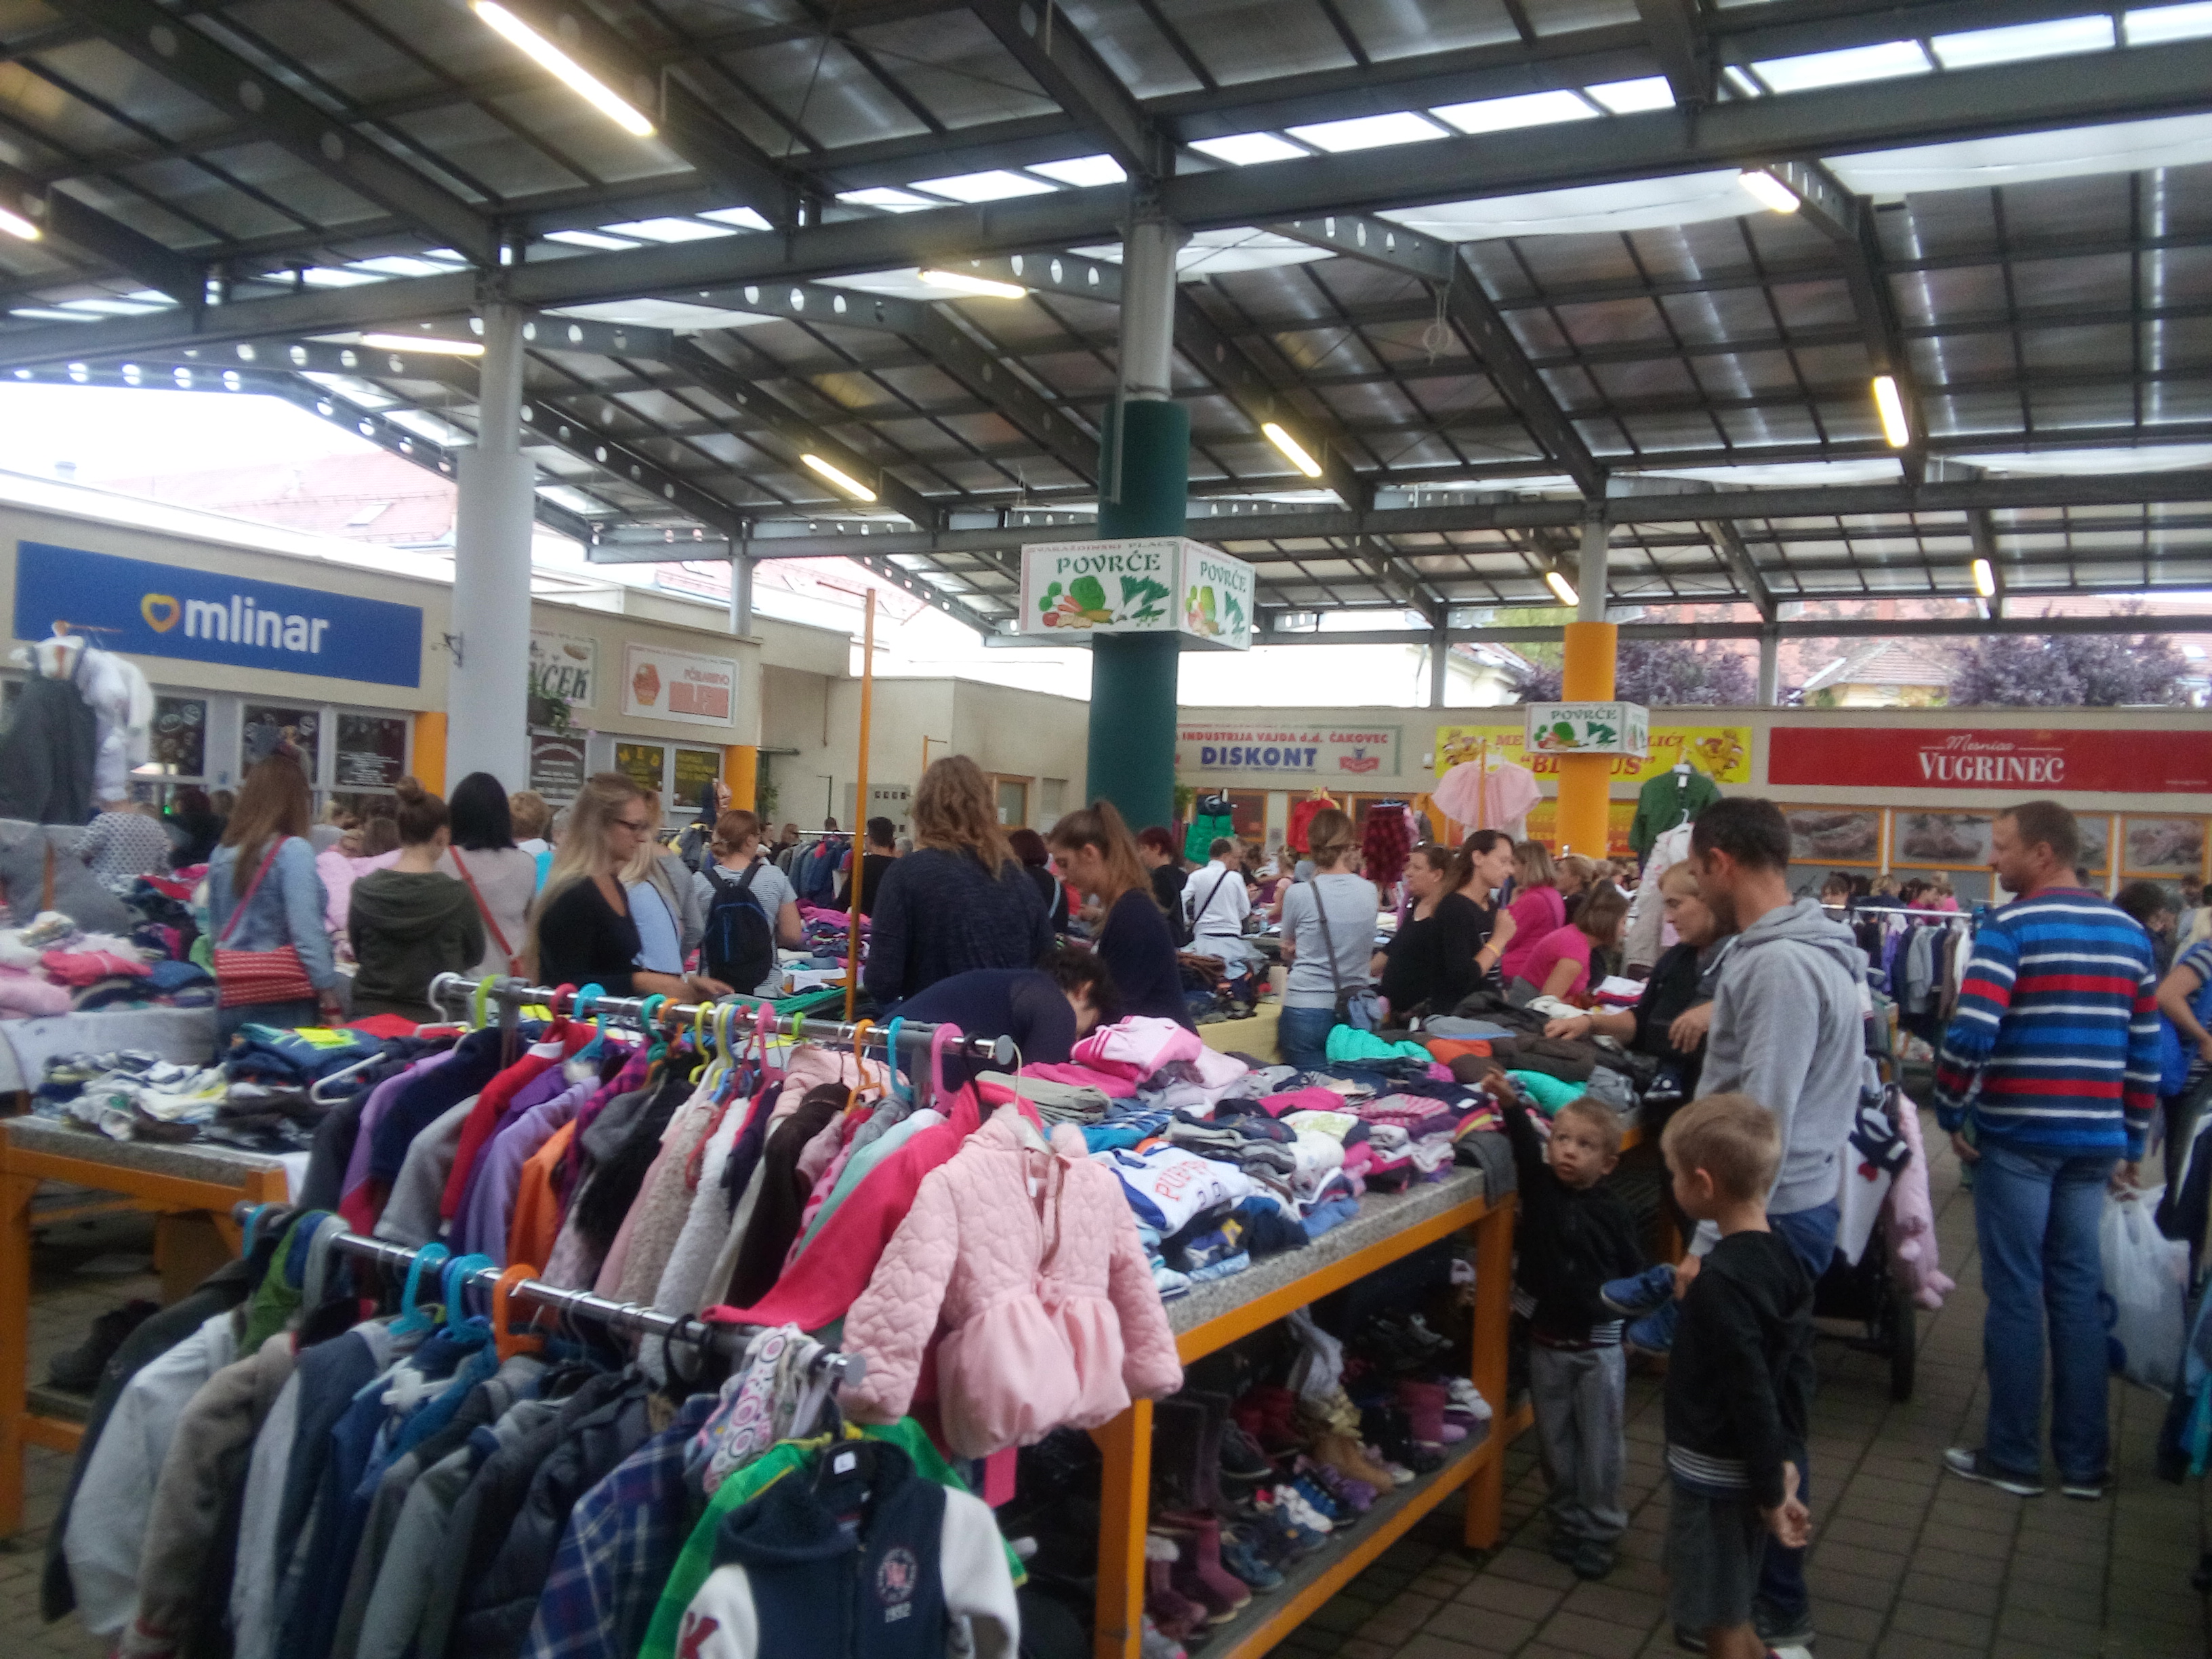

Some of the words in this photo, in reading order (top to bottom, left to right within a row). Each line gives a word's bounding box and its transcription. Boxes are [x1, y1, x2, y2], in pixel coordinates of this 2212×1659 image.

[184, 594, 329, 653] mlinar
[1182, 732, 1253, 741] INDUSTRIJA
[1257, 733, 1296, 742] VAJDA
[1329, 731, 1389, 743] ČAKOVEC
[1201, 746, 1317, 766] DISKONT
[1919, 752, 2065, 783] VUGRINEC
